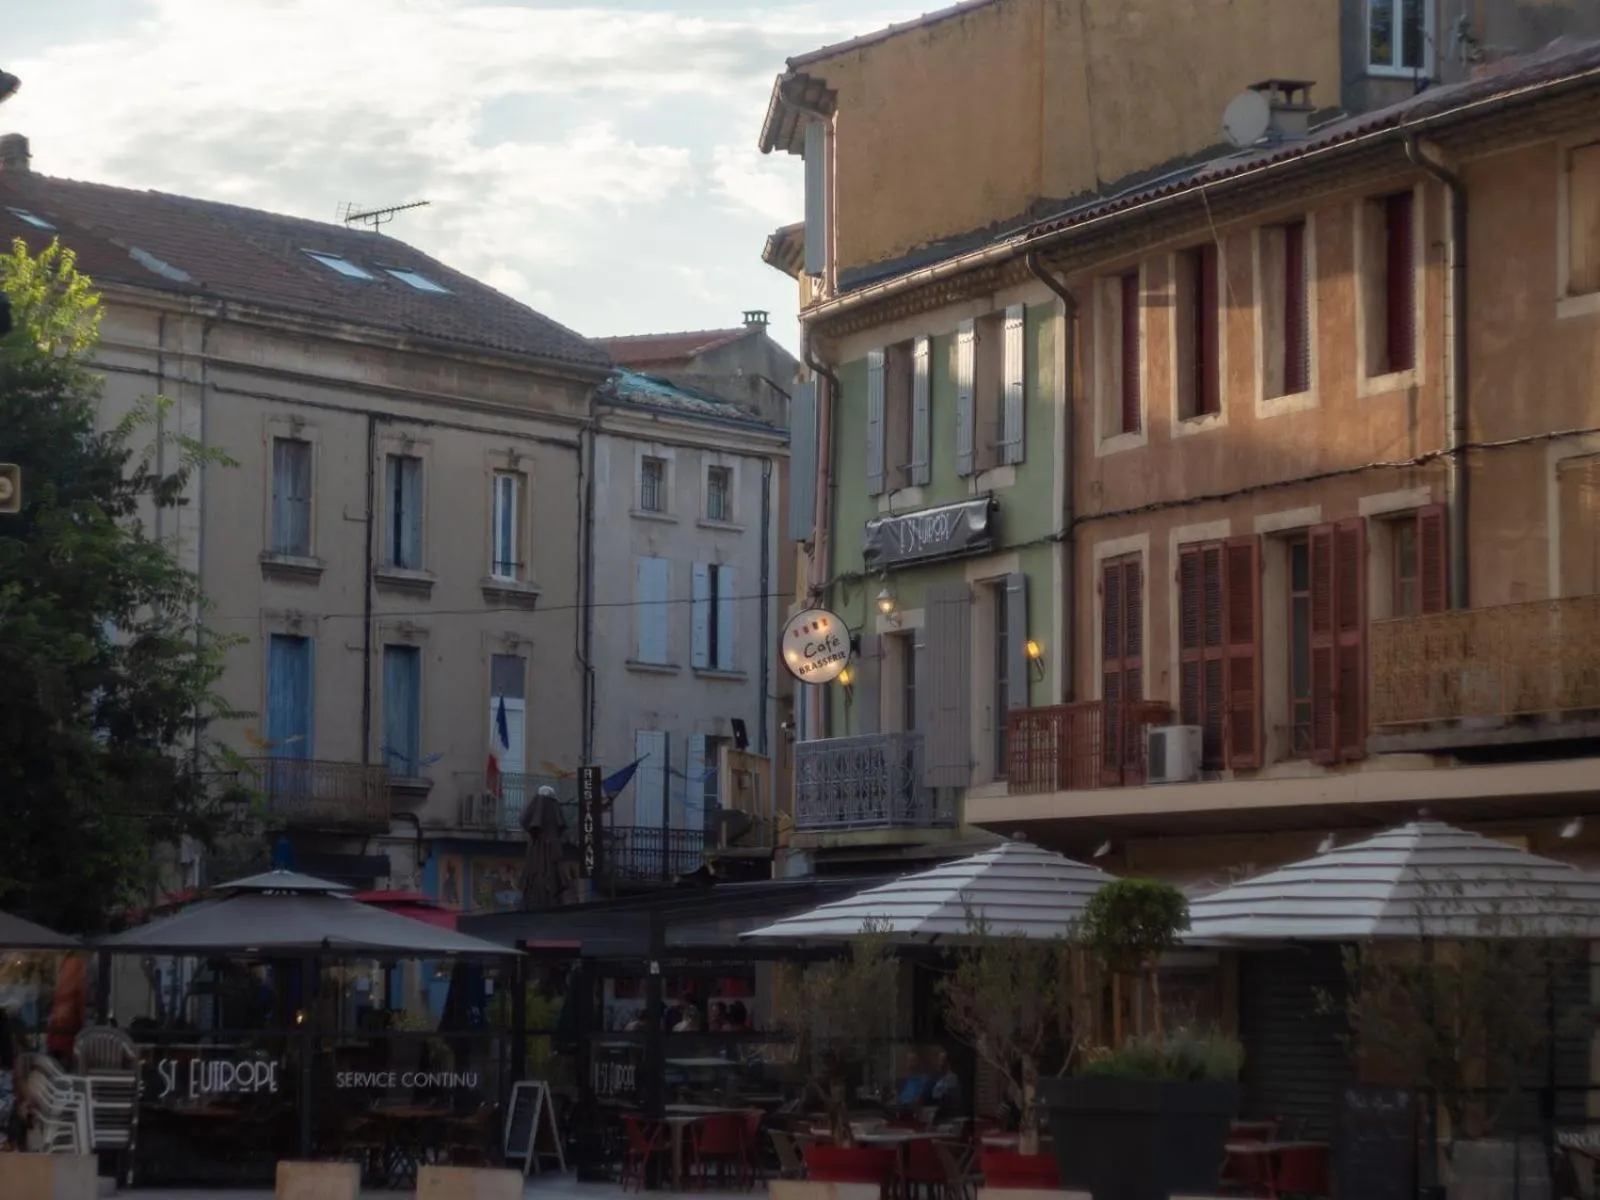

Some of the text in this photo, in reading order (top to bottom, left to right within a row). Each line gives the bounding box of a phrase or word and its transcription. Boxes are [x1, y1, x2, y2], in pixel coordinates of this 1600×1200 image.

[804, 634, 841, 659] Café
[799, 651, 846, 675] BRASSERIE
[583, 768, 594, 876] RESTAURANT
[189, 1058, 279, 1098] EUTROPE
[336, 1071, 479, 1088] SERVICE CONTINU
